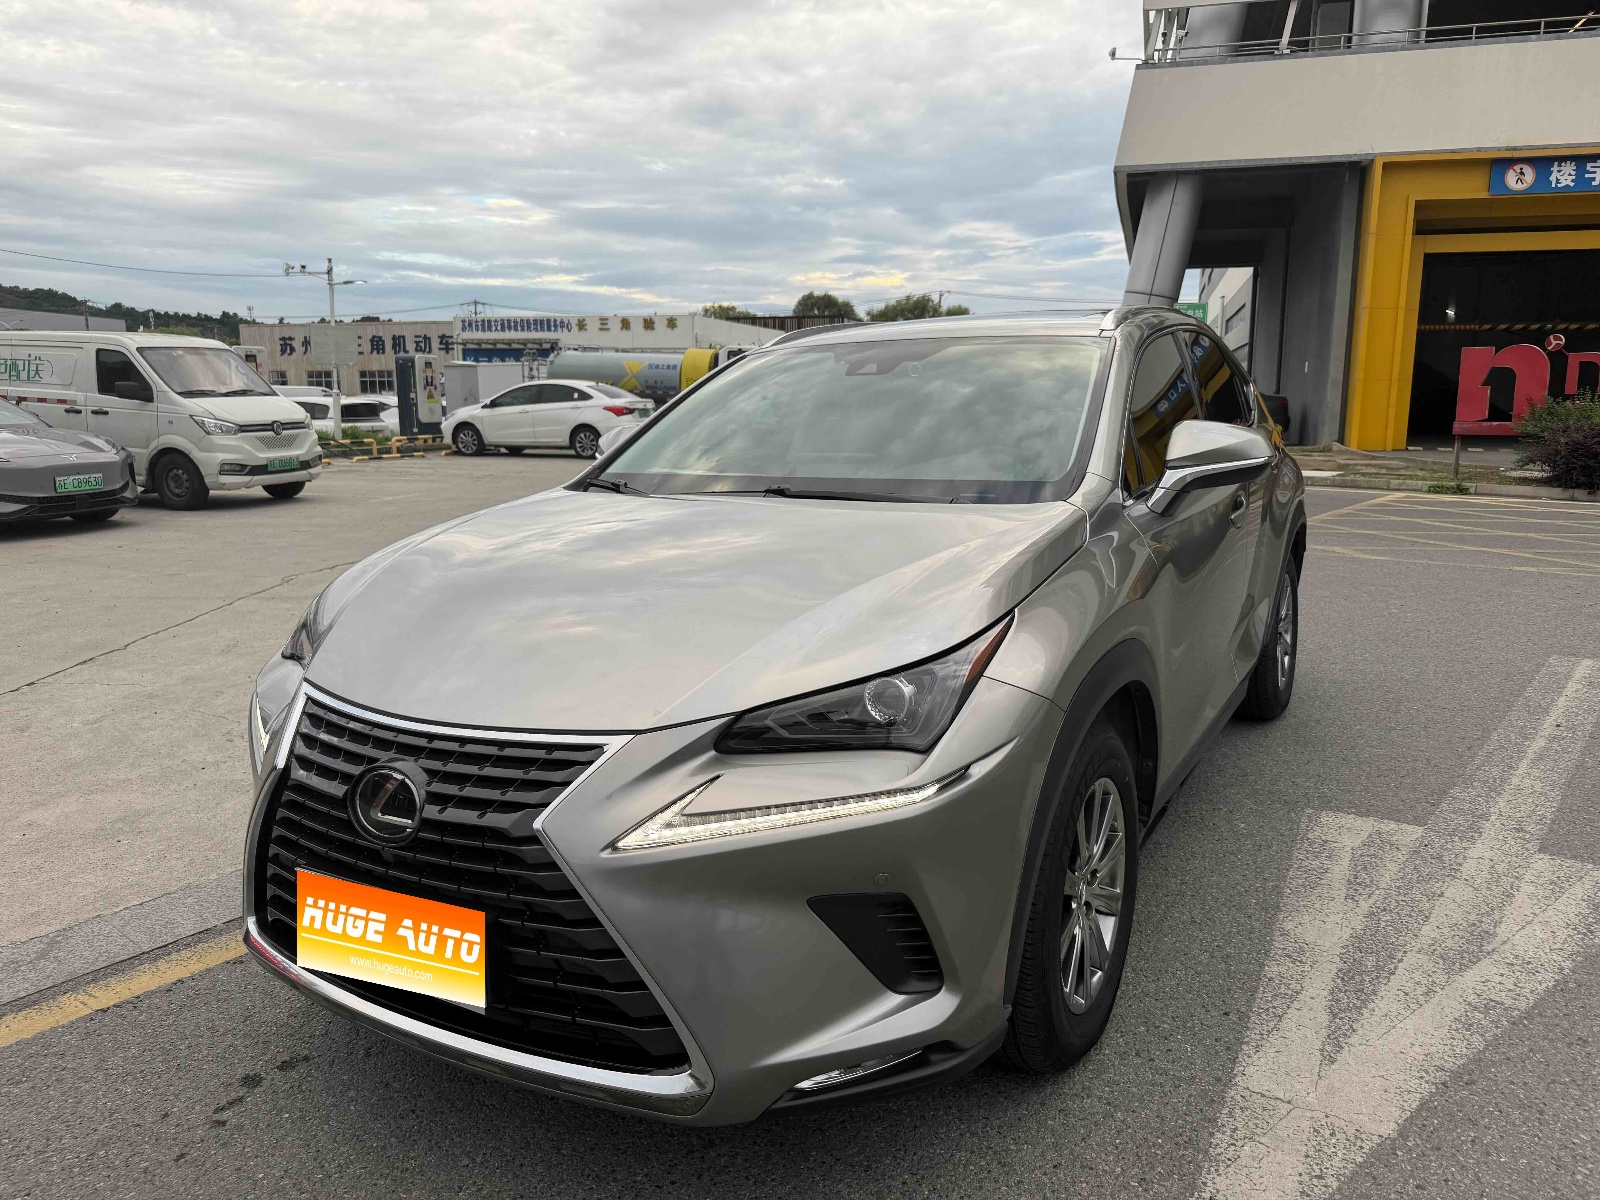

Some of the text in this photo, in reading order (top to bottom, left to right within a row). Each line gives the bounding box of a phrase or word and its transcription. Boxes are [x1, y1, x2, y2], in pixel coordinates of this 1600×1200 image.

[576, 317, 678, 332] 长三角验车
